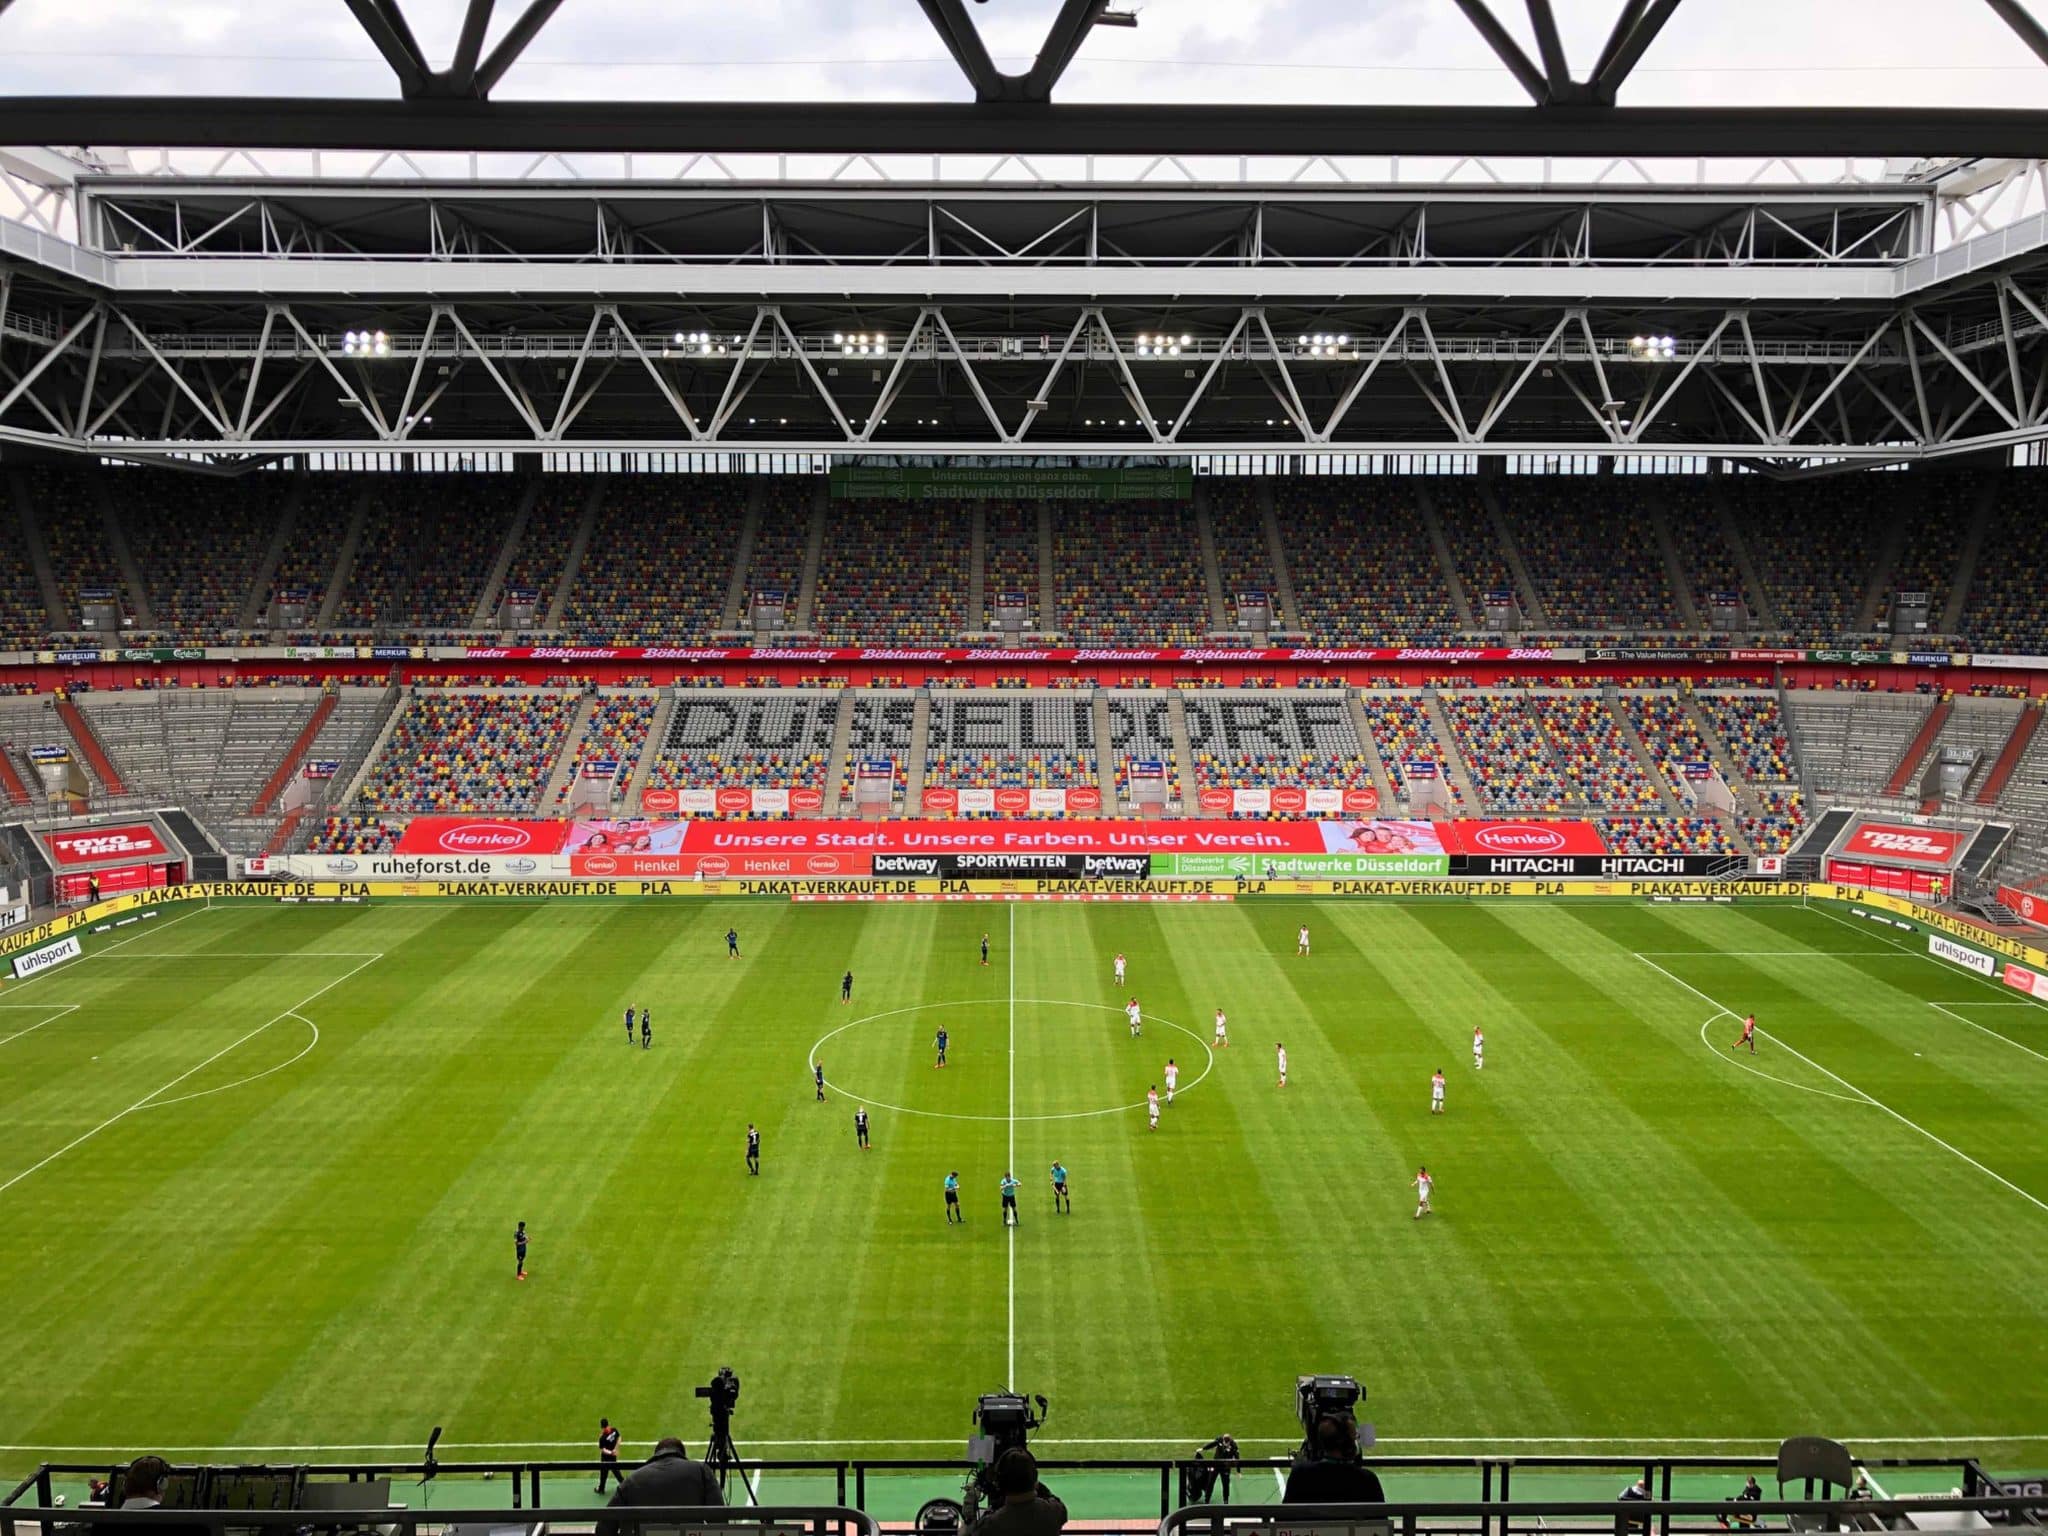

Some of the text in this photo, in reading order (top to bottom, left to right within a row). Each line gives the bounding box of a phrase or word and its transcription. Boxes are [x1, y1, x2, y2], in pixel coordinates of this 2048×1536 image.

[922, 484, 1013, 498] Stadtwerke
[1015, 484, 1101, 498] Düsseldorf
[375, 648, 407, 657] MERKUR
[530, 648, 618, 659] Böklunder
[641, 648, 730, 659] Böklunder
[750, 648, 837, 659] Böklunder
[860, 648, 946, 659] Böklunder
[966, 648, 1052, 659] Böklunder
[1074, 648, 1160, 659] Böklunder
[1179, 648, 1265, 659] Böklunder
[1289, 648, 1376, 659] Böklunder
[1396, 648, 1484, 659] Böklunder
[1621, 651, 1689, 659] The Value Network
[1911, 655, 1949, 663] MERKUR
[648, 796, 674, 804] Henkel
[722, 796, 747, 804] Henkel
[794, 796, 819, 804] Henkel
[928, 796, 953, 804] Henkel
[1000, 796, 1025, 804] Henkel
[1070, 796, 1096, 804] Henkel
[1204, 796, 1229, 804] Henkel
[1276, 796, 1301, 804] Henkel
[1348, 796, 1373, 804] Henkel
[56, 835, 129, 849] TOYO
[446, 833, 523, 845] Henkel
[713, 832, 1291, 846] Unsere Stadt. Unsere Farben. Unser Verein.
[1483, 832, 1557, 846] Henkel
[1862, 831, 1932, 845] TOYO
[75, 841, 152, 856] TIRES
[1870, 840, 1948, 855] TIRES
[372, 858, 491, 874] ruheforst.de
[586, 861, 615, 869] Henkel
[634, 860, 680, 871] Henkel
[699, 861, 727, 869] Henkel
[744, 860, 790, 871] Henkel
[809, 860, 837, 869] Henkel
[875, 856, 938, 874] betway
[957, 855, 1066, 867] SPORTWETTEN
[1085, 856, 1147, 874] betway
[1181, 856, 1225, 864] Stadtwerke
[1261, 857, 1442, 872] Stadtwerke Düsseldorf
[1490, 858, 1574, 873] HITACHI
[1601, 858, 1685, 873] HITACHI
[339, 883, 371, 895] PLA
[438, 882, 617, 895] PLAKAT-VERKAUFT.DE
[641, 882, 672, 894] PLA
[740, 881, 916, 894] PLAKAT-VERKAUFT.DE
[939, 881, 970, 893] PLA
[1037, 880, 1214, 893] PLAKAT-VERKAUFT.DE
[1237, 881, 1266, 893] PLA
[1332, 882, 1512, 894] PLAKAT-VERKAUFT.DE
[1536, 882, 1565, 894] PLA
[1631, 882, 1810, 895] PLAKAT-VERKAUFT.DE
[133, 882, 316, 904] PLAKAT-VERKAUFT.DE
[1836, 886, 1864, 901] PLA
[67, 911, 87, 929] PLA
[1912, 905, 2027, 960] PLAKAT-VERKAUFT.DE
[21, 941, 74, 971] uhlsport
[1934, 940, 1986, 969] uhlsport
